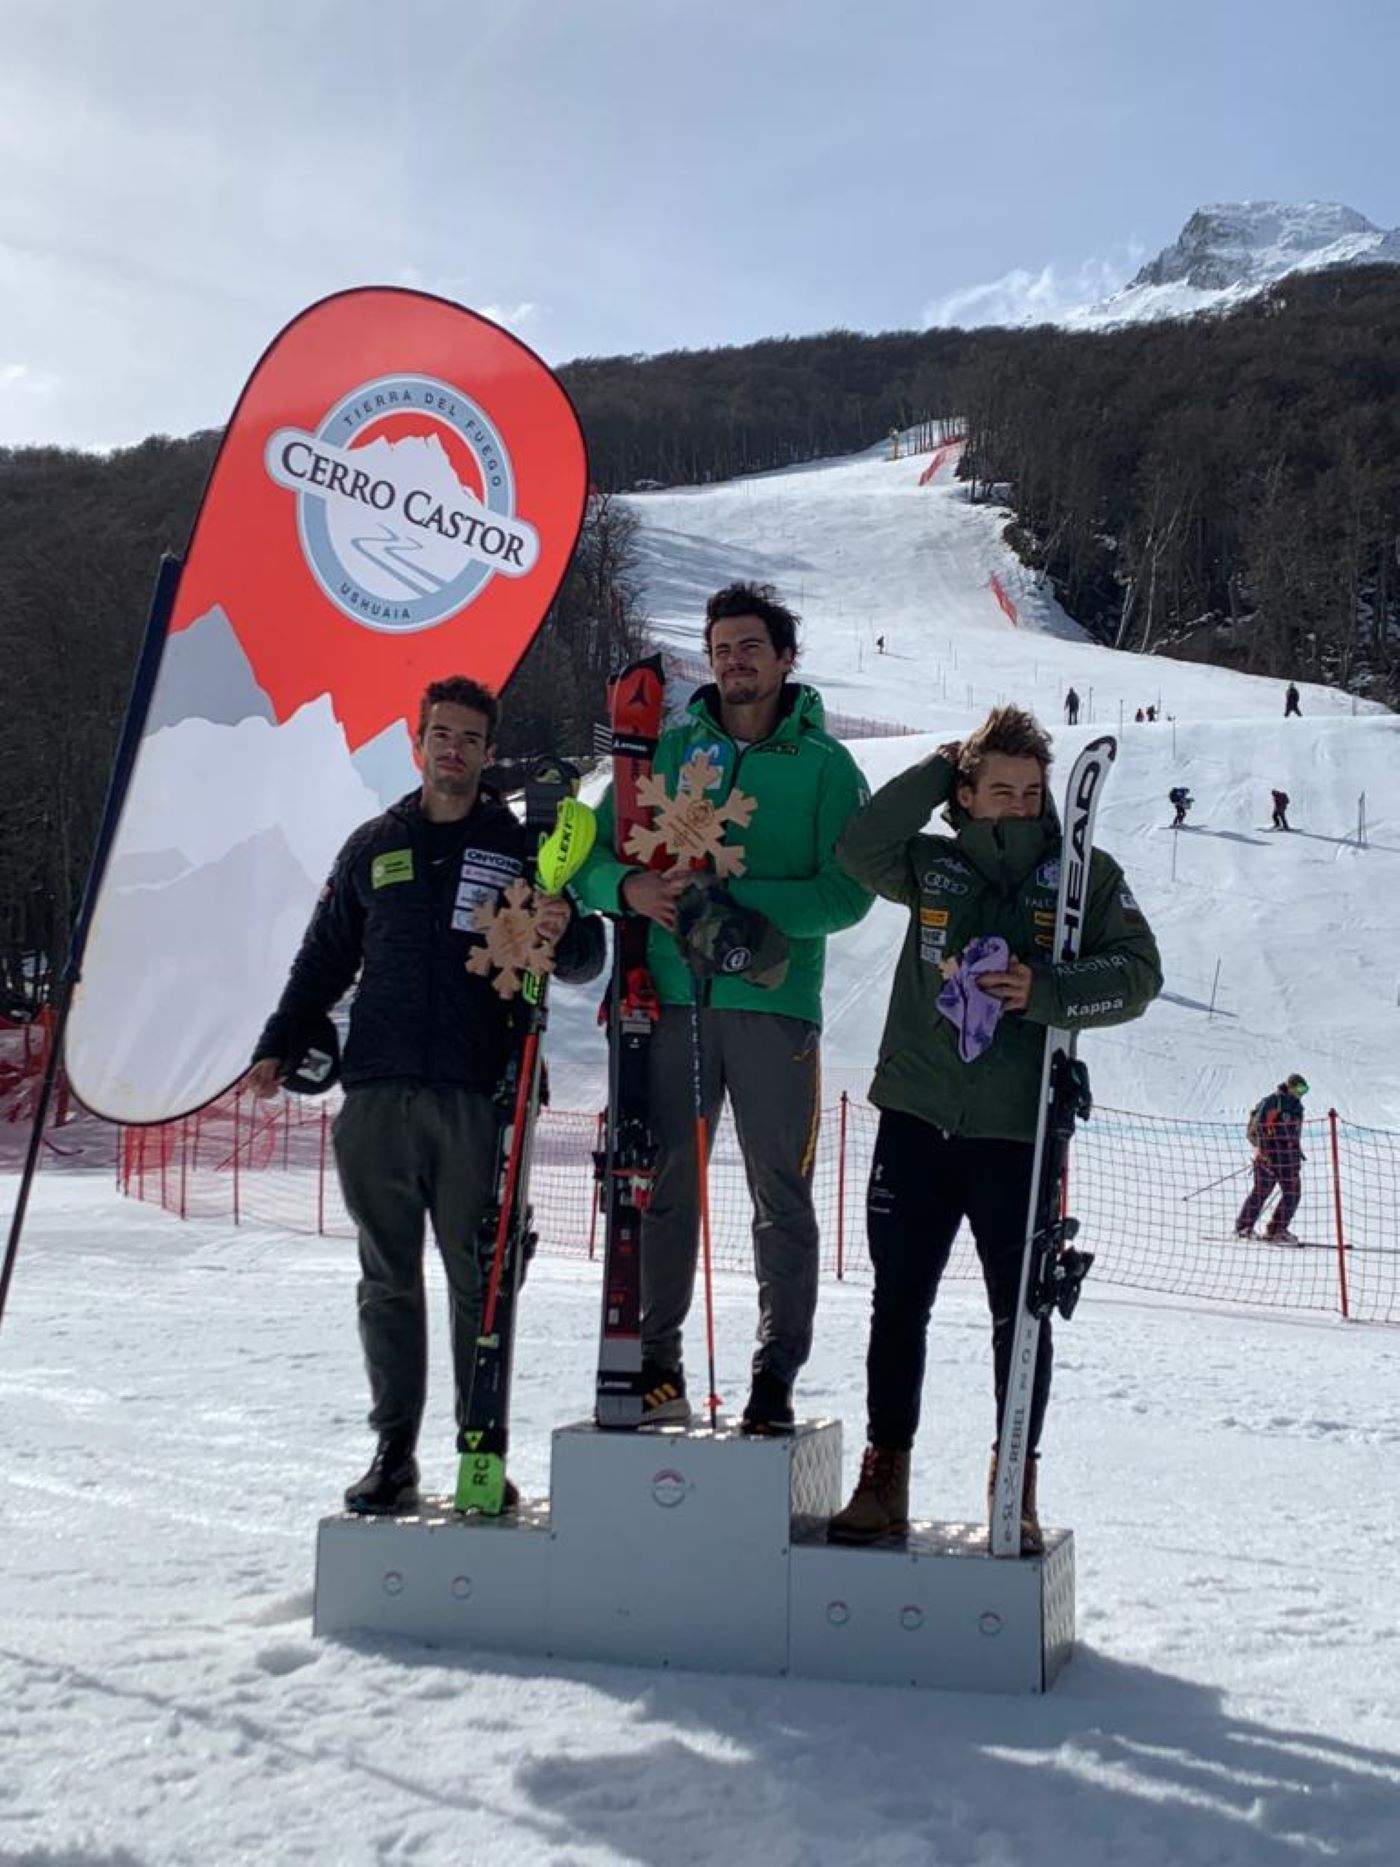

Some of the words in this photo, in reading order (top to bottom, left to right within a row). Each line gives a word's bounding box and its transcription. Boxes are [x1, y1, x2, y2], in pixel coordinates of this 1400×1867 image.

[343, 390, 412, 427] TIERRA
[424, 392, 457, 416] DEL
[465, 419, 501, 487] FUEGO
[281, 441, 395, 510] CERRO
[403, 489, 524, 567] CASTOR
[340, 582, 411, 620] USHUAIA
[556, 822, 572, 863] LEKI
[1061, 761, 1101, 961] HEAD
[1067, 998, 1123, 1017] Kappa
